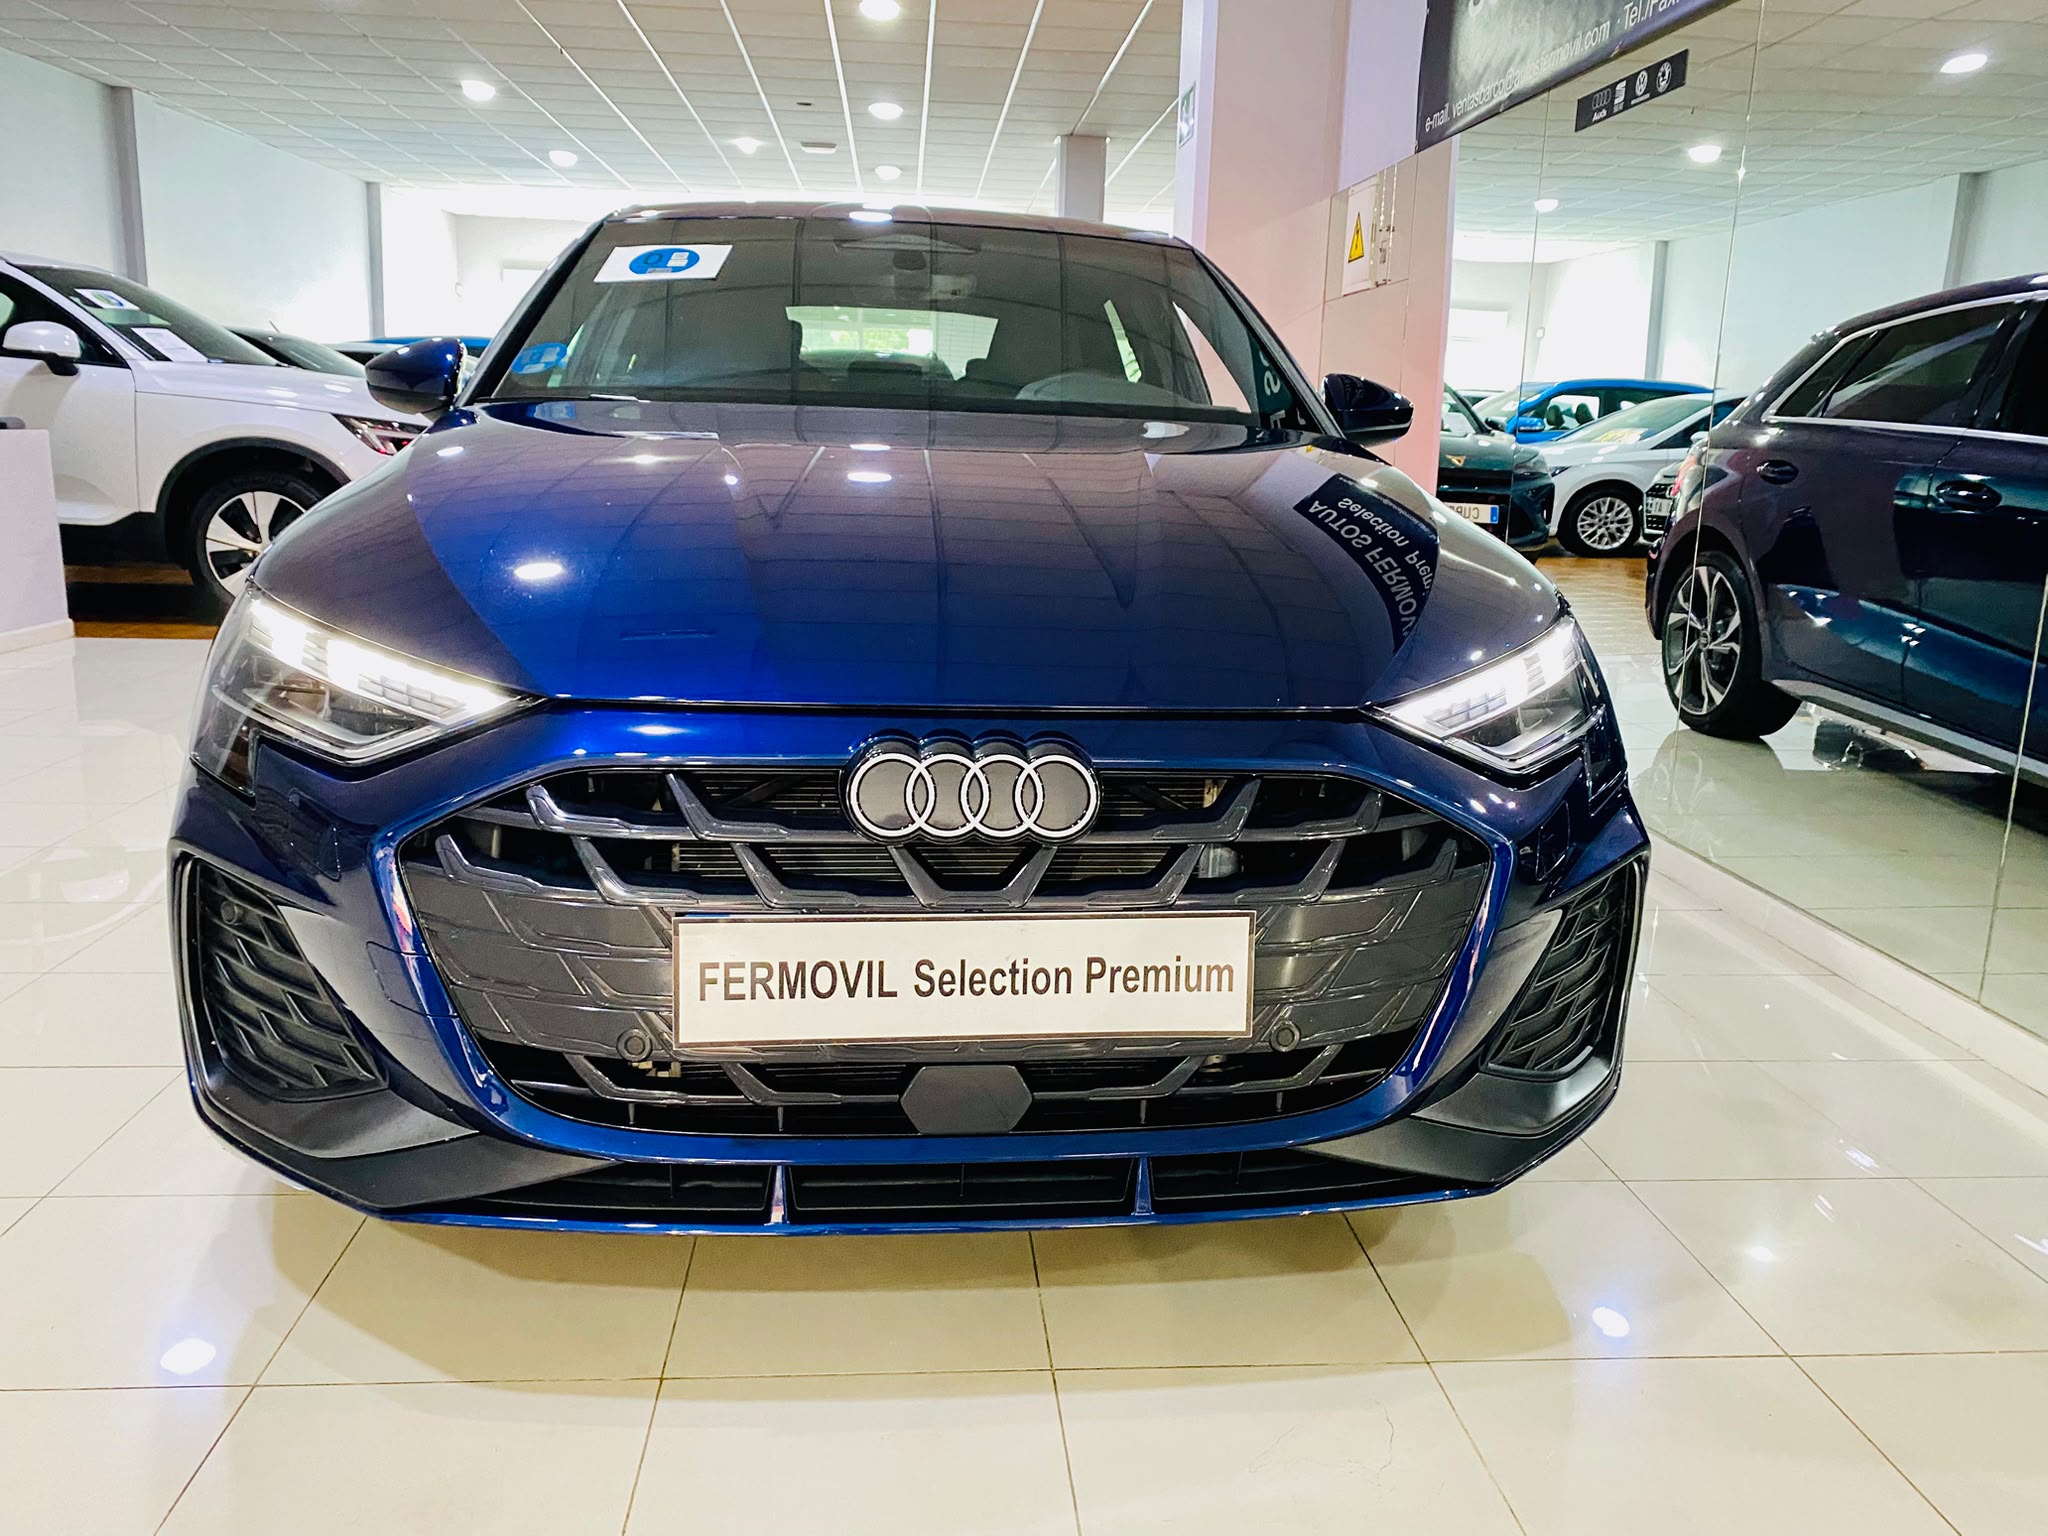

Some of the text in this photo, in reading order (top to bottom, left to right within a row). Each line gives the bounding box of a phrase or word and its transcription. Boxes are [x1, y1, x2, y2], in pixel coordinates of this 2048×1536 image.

[699, 955, 1235, 1001] FERMOVIL Selection Premium
